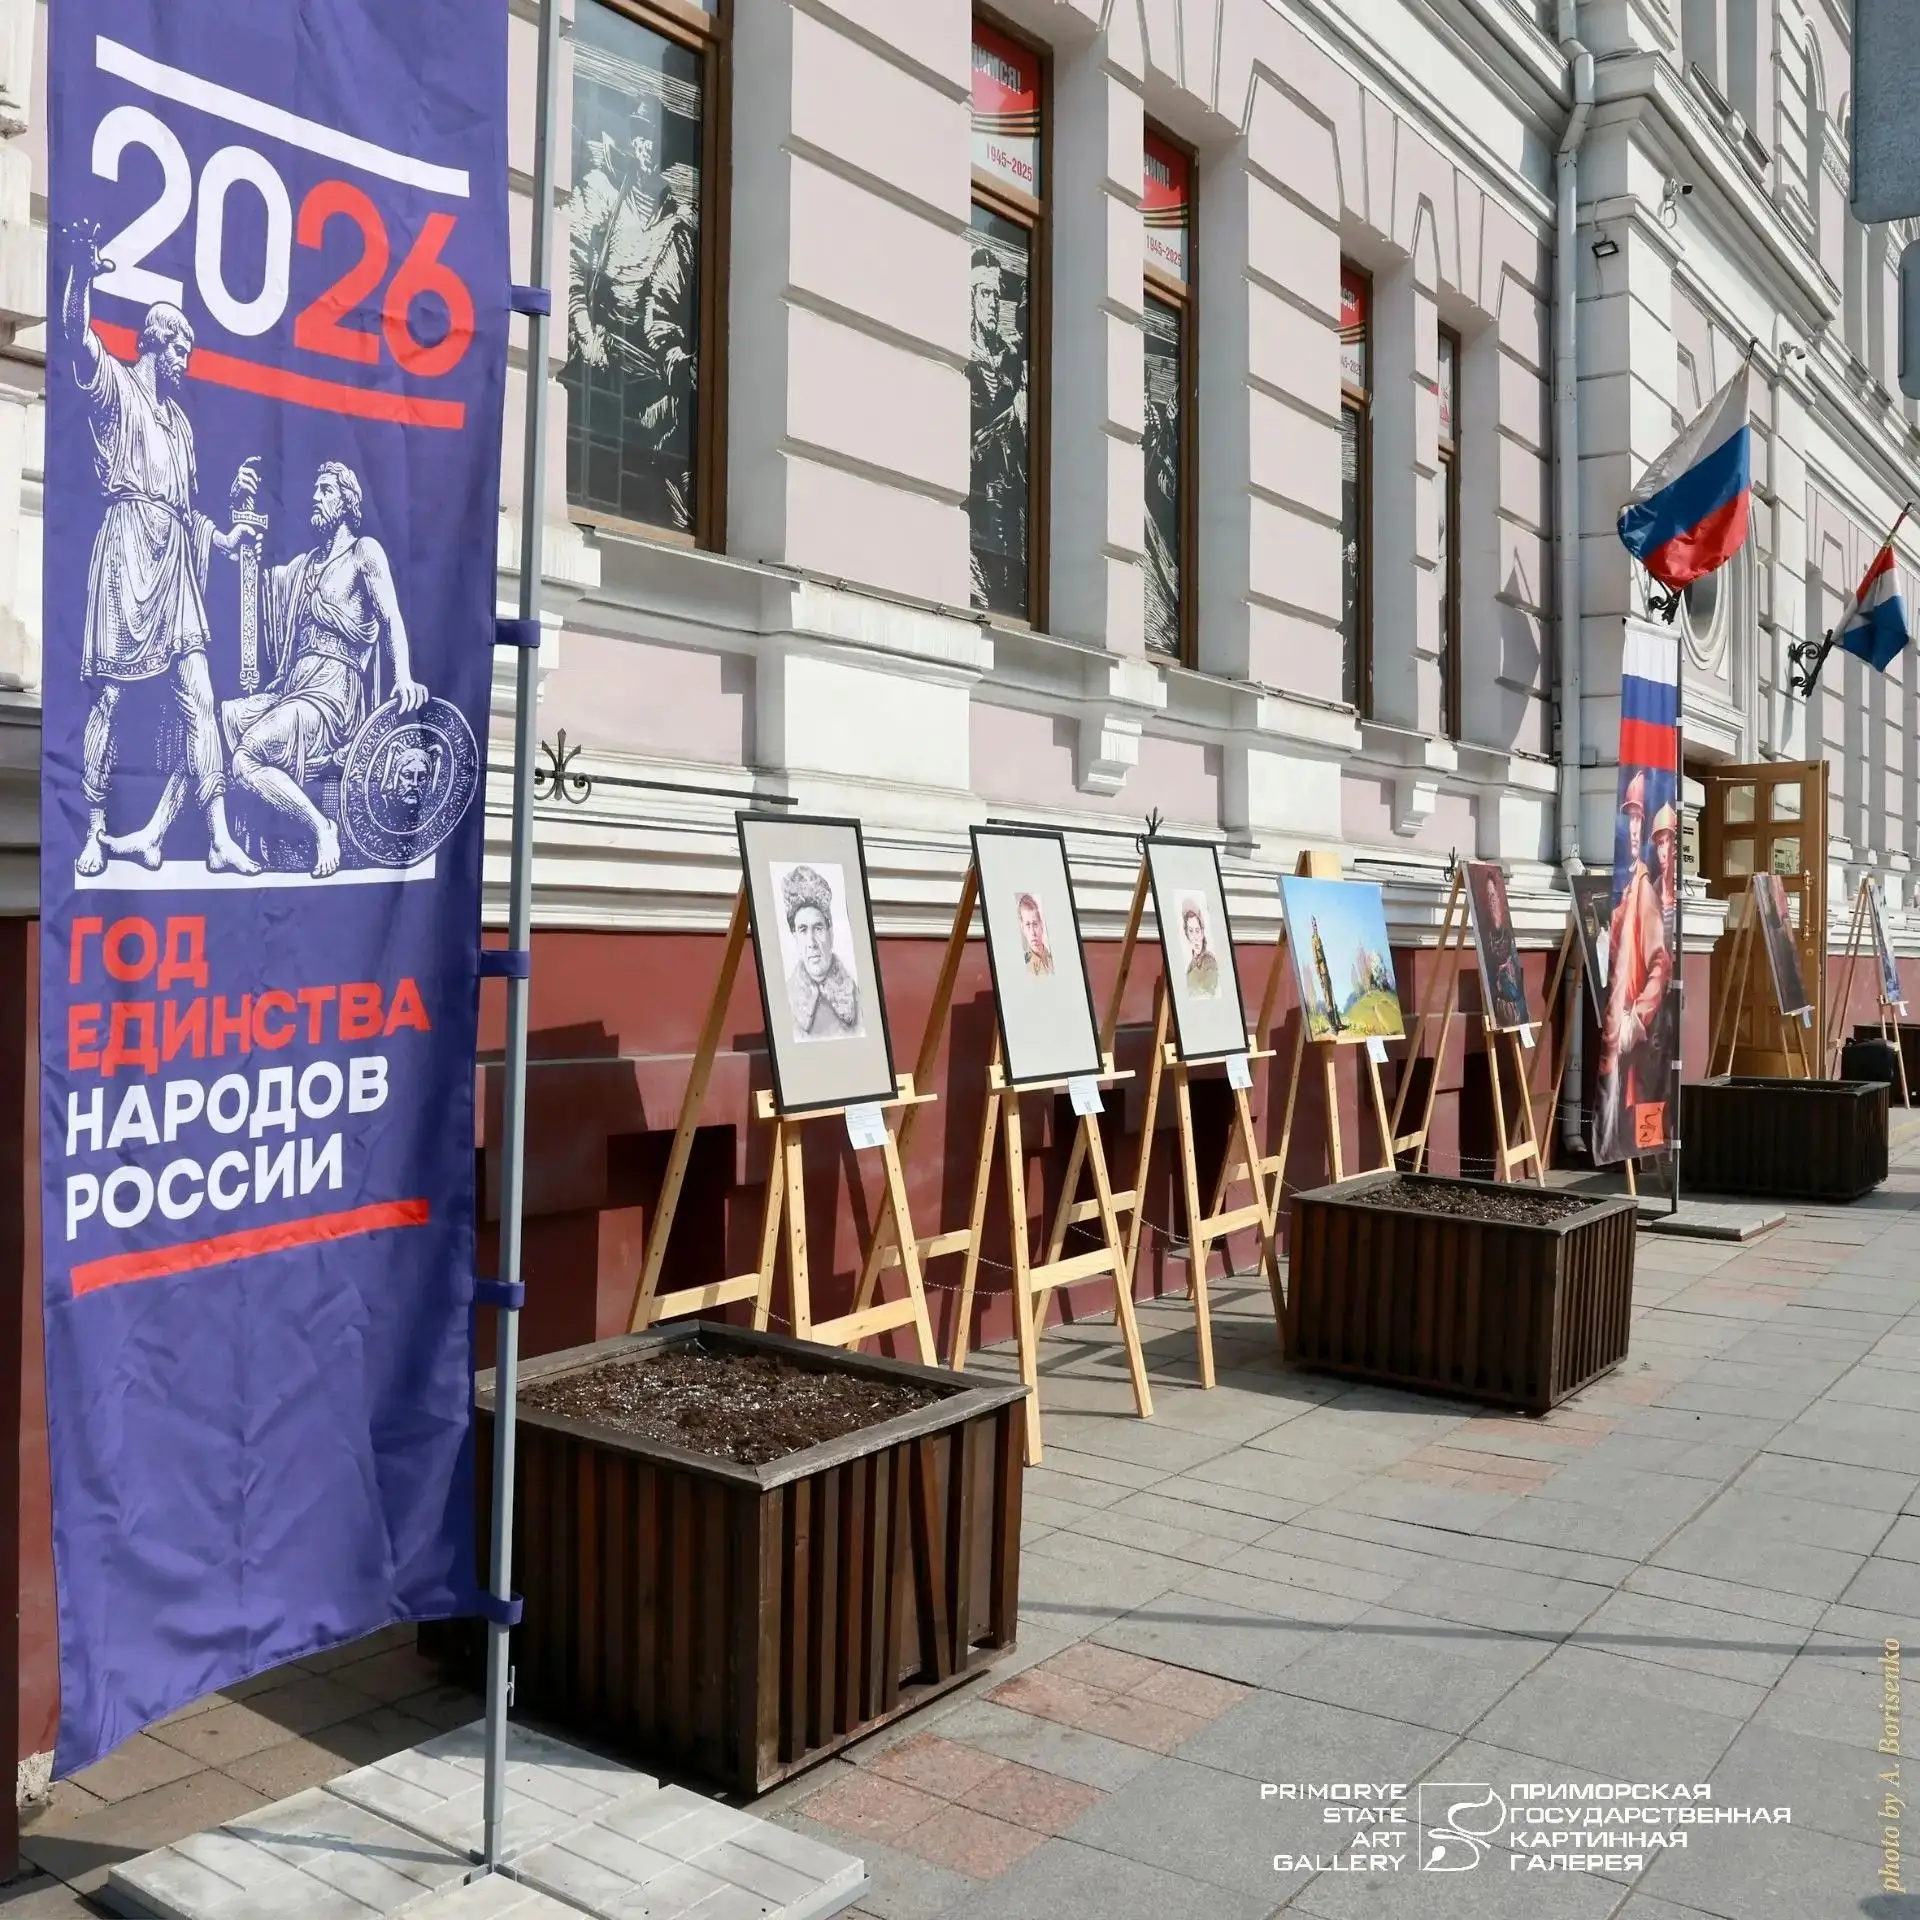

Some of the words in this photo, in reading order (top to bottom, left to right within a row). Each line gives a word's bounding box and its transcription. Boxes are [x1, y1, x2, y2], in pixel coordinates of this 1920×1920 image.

[986, 142, 1033, 182] 1945-2025
[91, 105, 474, 378] 2026
[69, 916, 209, 991] ГОД
[67, 977, 431, 1077] ЕДИНСТВА
[65, 1055, 390, 1157] НАРОДОВ
[65, 1132, 343, 1242] РОССИИ
